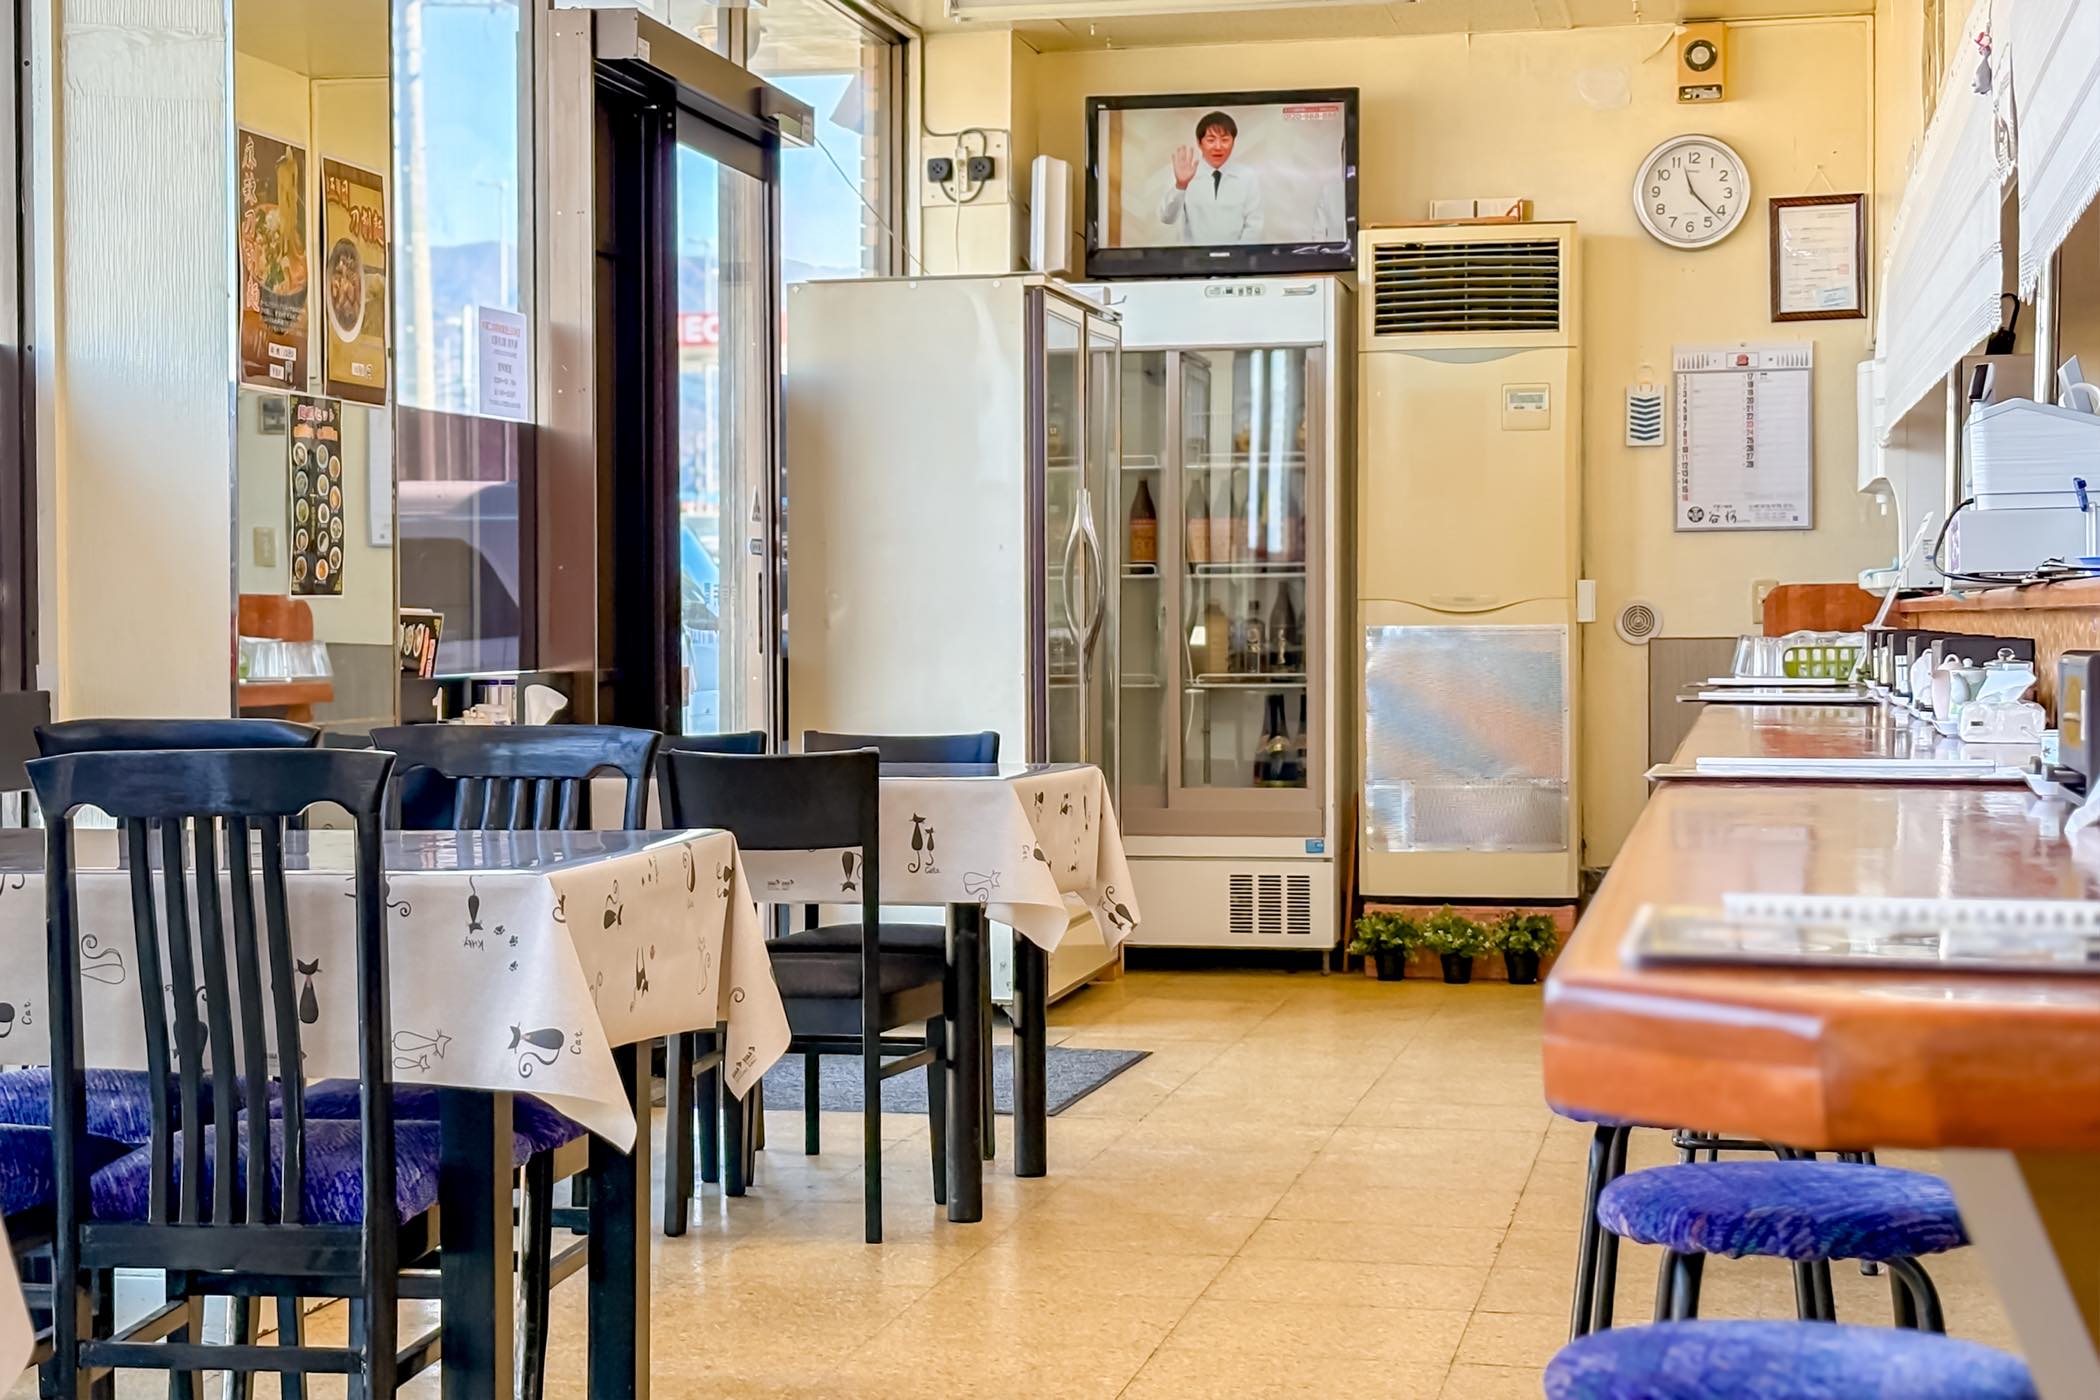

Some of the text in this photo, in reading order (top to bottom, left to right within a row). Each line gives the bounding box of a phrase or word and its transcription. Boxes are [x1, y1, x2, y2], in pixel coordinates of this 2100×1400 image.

[1672, 156, 1681, 168] 11
[1688, 152, 1701, 164] 12
[1711, 156, 1714, 168] 1
[1657, 169, 1671, 181] 10
[1719, 169, 1729, 182] 2
[1651, 186, 1661, 198] 9
[1723, 187, 1733, 199] 3
[1656, 203, 1665, 215] 8
[1716, 204, 1726, 216] 4
[1668, 216, 1678, 228] 7
[1685, 221, 1695, 233] 6
[1704, 216, 1712, 228] 5
